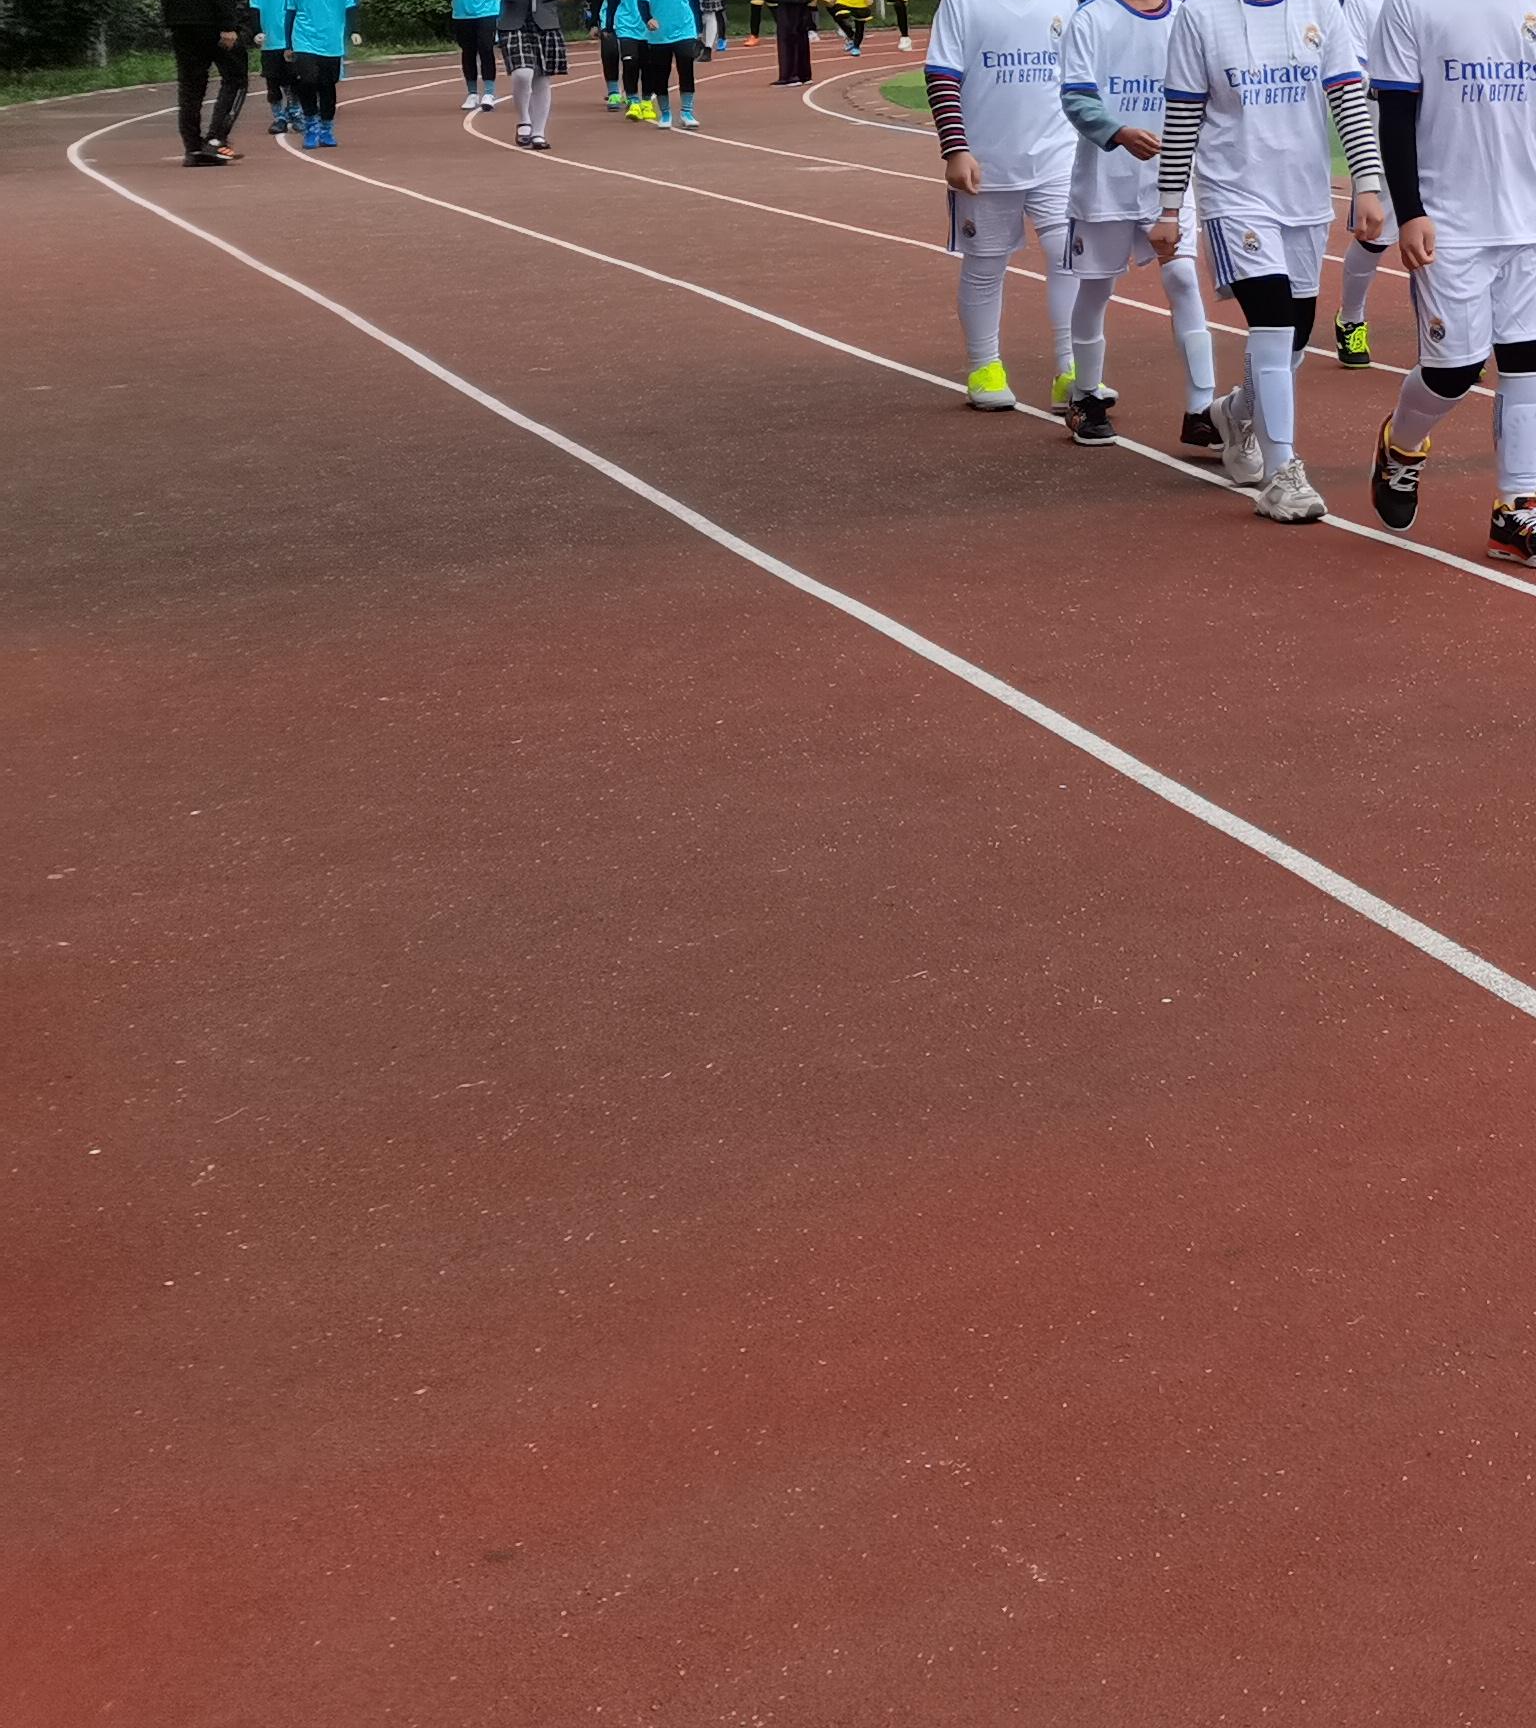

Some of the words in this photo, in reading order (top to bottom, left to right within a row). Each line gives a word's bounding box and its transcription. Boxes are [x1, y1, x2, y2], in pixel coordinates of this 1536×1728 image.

[996, 69, 1013, 84] FLY
[1108, 75, 1165, 95] Emira
[1223, 64, 1319, 88] Emirates
[1242, 89, 1261, 106] FLY
[1265, 85, 1307, 105] BETTER
[1461, 84, 1484, 103] FLY
[1118, 98, 1138, 112] FLY
[1142, 97, 1164, 112] BET
